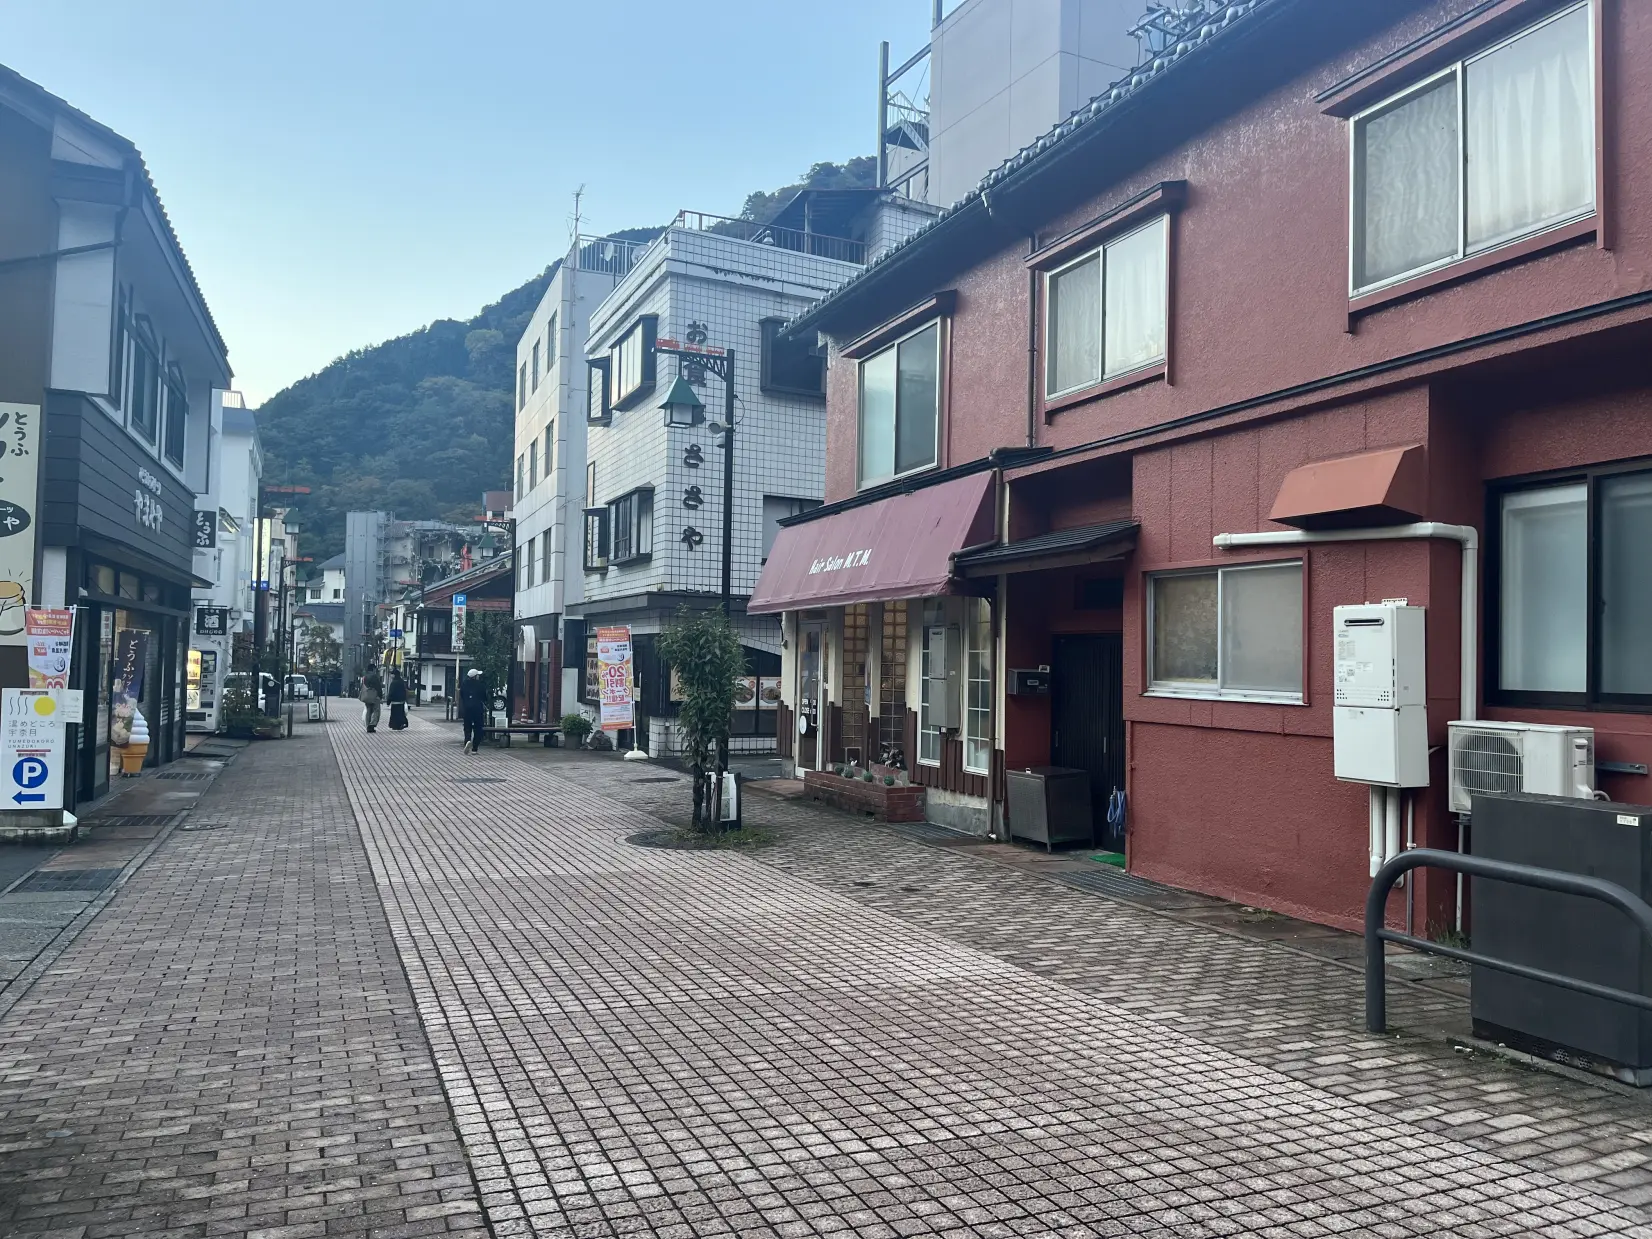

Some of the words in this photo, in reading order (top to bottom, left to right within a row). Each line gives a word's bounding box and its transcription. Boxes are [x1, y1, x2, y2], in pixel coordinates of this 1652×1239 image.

[11, 411, 30, 457] とうふ
[195, 511, 211, 546] とうふ
[824, 555, 844, 572] Salon
[457, 596, 464, 604] P
[204, 614, 219, 628] 酒
[123, 639, 139, 671] とうふ
[8, 728, 37, 737] 宇奈月
[22, 761, 42, 785] P
